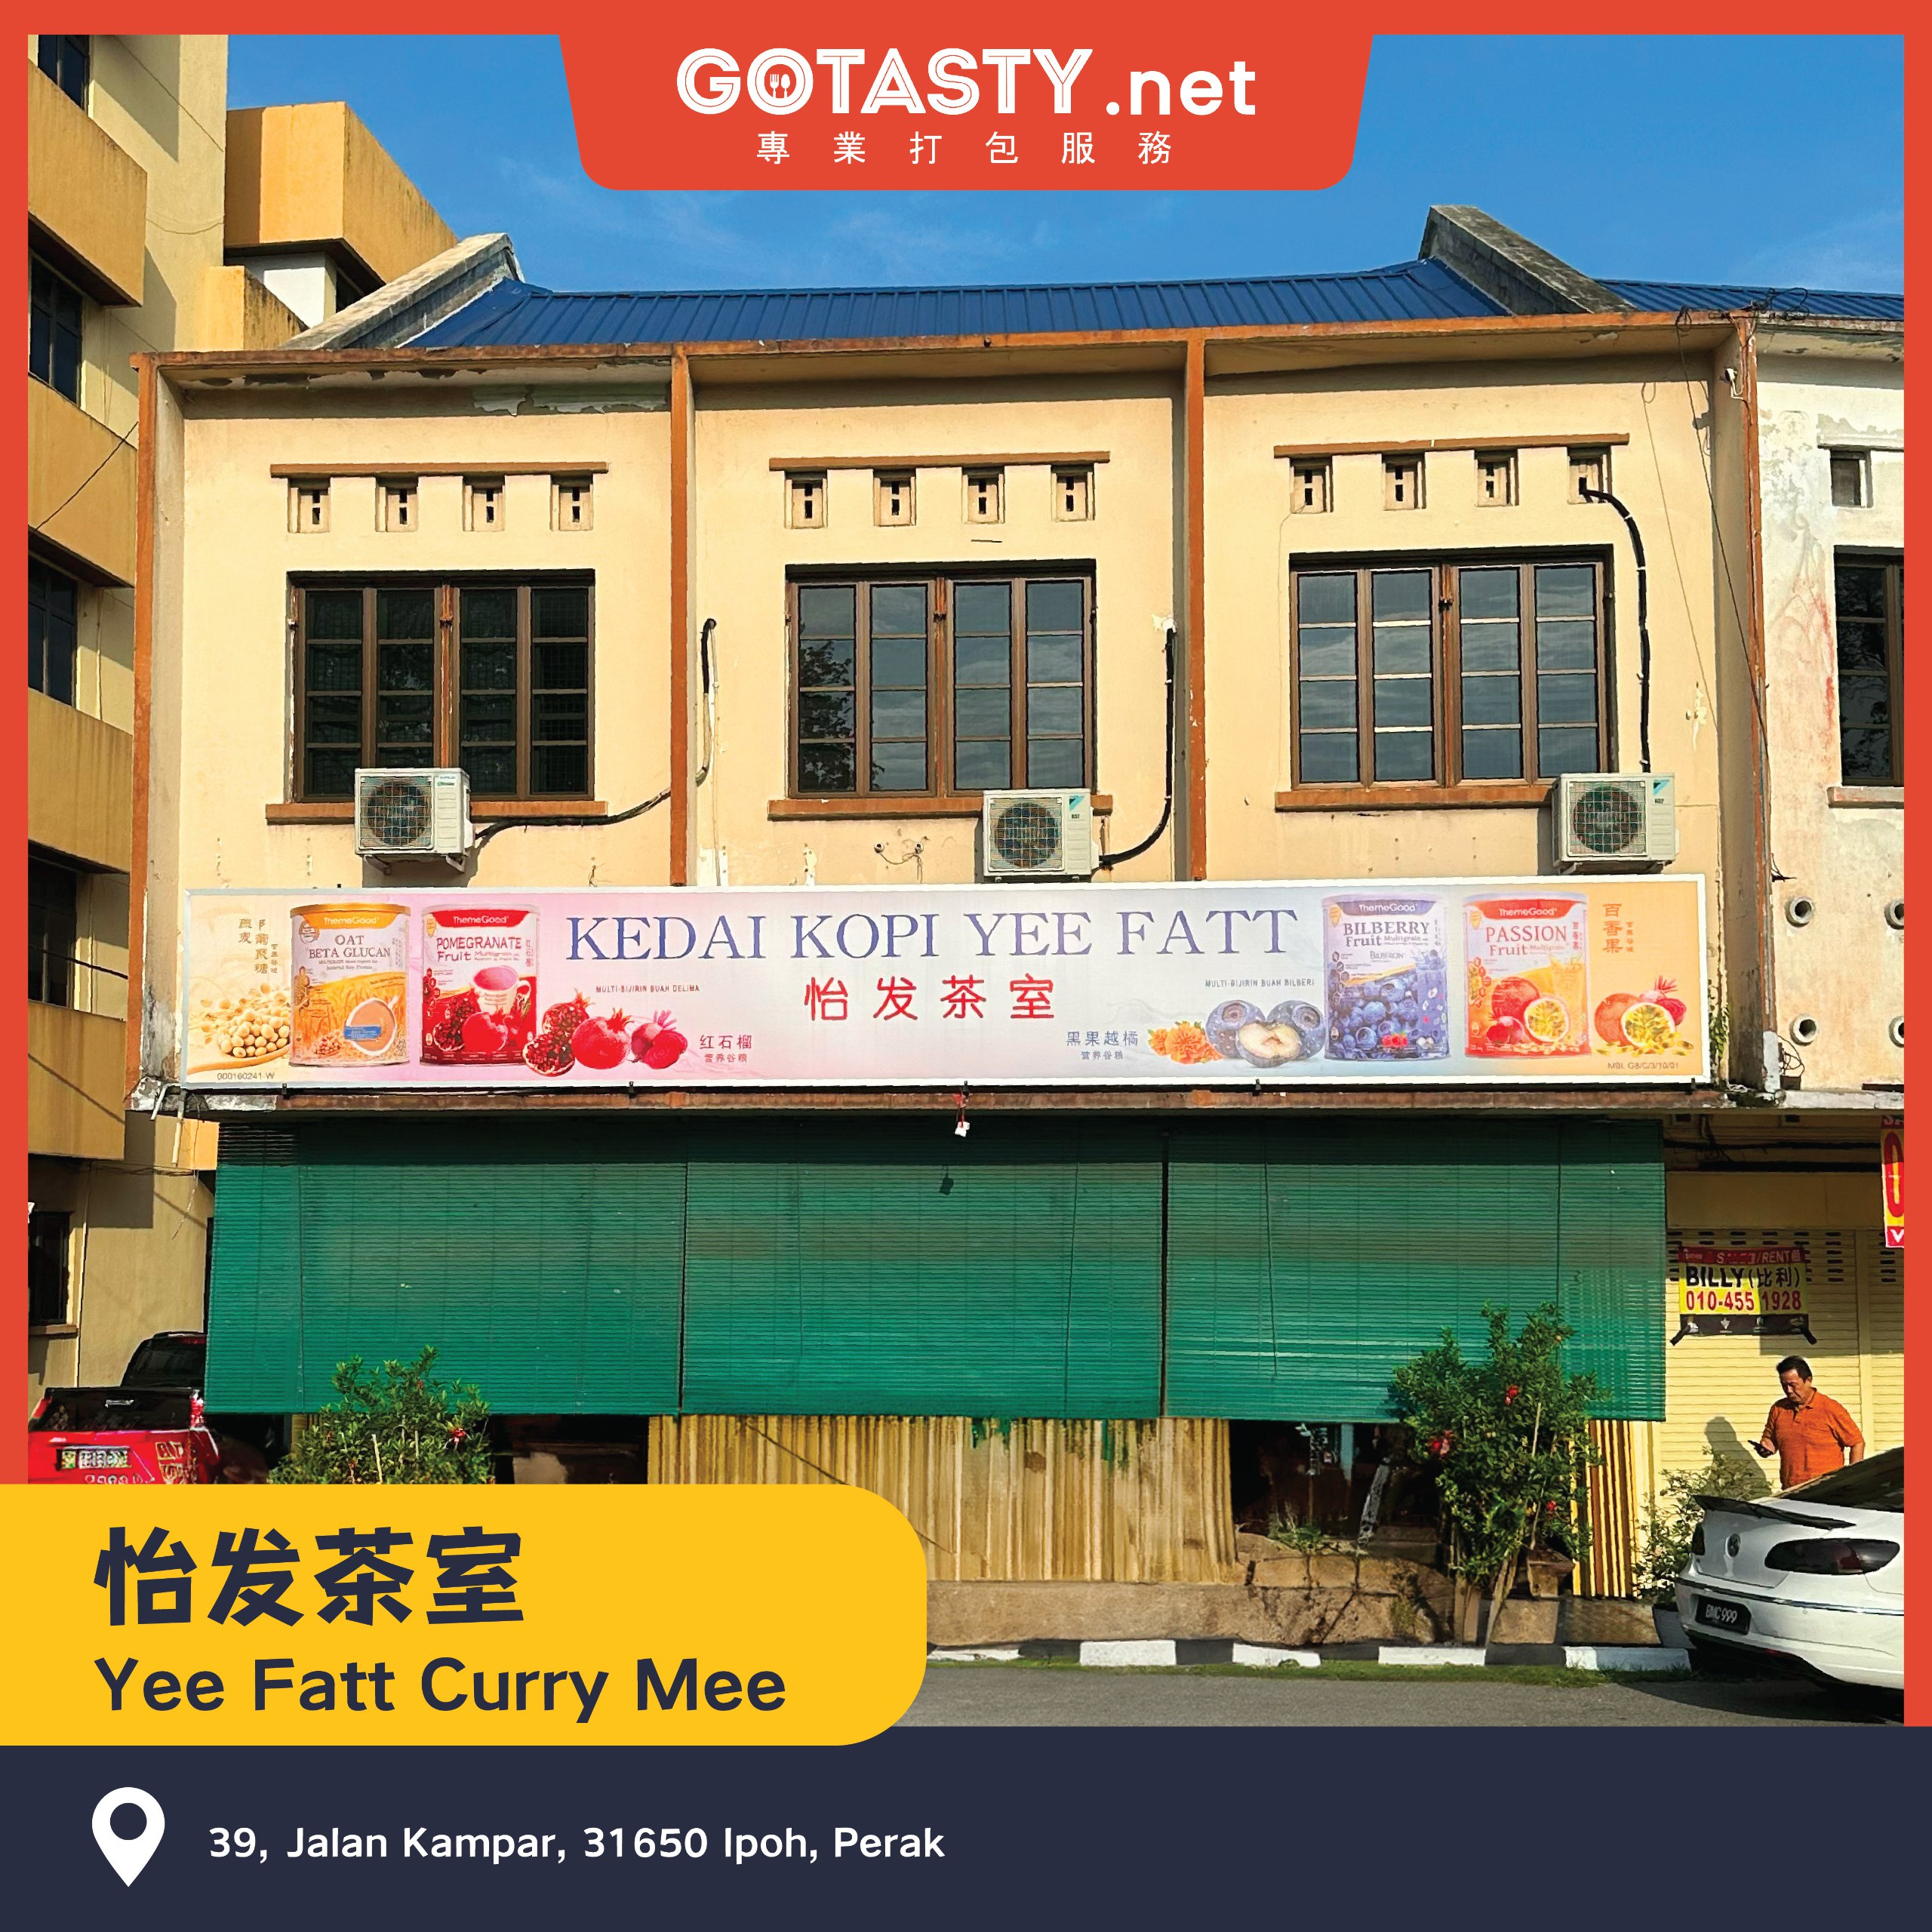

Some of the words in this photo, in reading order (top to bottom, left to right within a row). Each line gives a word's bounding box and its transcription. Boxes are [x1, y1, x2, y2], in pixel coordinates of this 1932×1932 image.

[1359, 903, 1416, 912] ThemeGood
[1499, 908, 1555, 916] ThemeGood
[323, 916, 377, 925] ThemeGood
[453, 915, 507, 924] ThemeGood
[566, 915, 765, 960] KEDAI
[791, 914, 940, 958] KOPI
[964, 912, 1092, 956] YEE
[1117, 909, 1298, 955] FATT
[1343, 921, 1429, 936] BILBERRY
[1485, 925, 1567, 943] PASSION
[1602, 903, 1623, 954] 百香果
[334, 934, 365, 946] OAT
[436, 936, 522, 950] POMEGRANATE
[1346, 934, 1383, 947] Fruit
[309, 948, 340, 959] BETA
[343, 947, 391, 958] GLUCAN
[1489, 943, 1527, 956] Fruit
[437, 951, 472, 962] Fruit
[650, 984, 669, 993] BUAH
[672, 984, 700, 992] DELIMA
[1261, 979, 1282, 987] BUAH
[1284, 978, 1315, 986] BILBERI
[804, 973, 1054, 1021] 怡发茶室
[699, 1034, 752, 1050] 红石榴
[1686, 1291, 1755, 1312] 010-455
[1761, 1290, 1801, 1312] 1928
